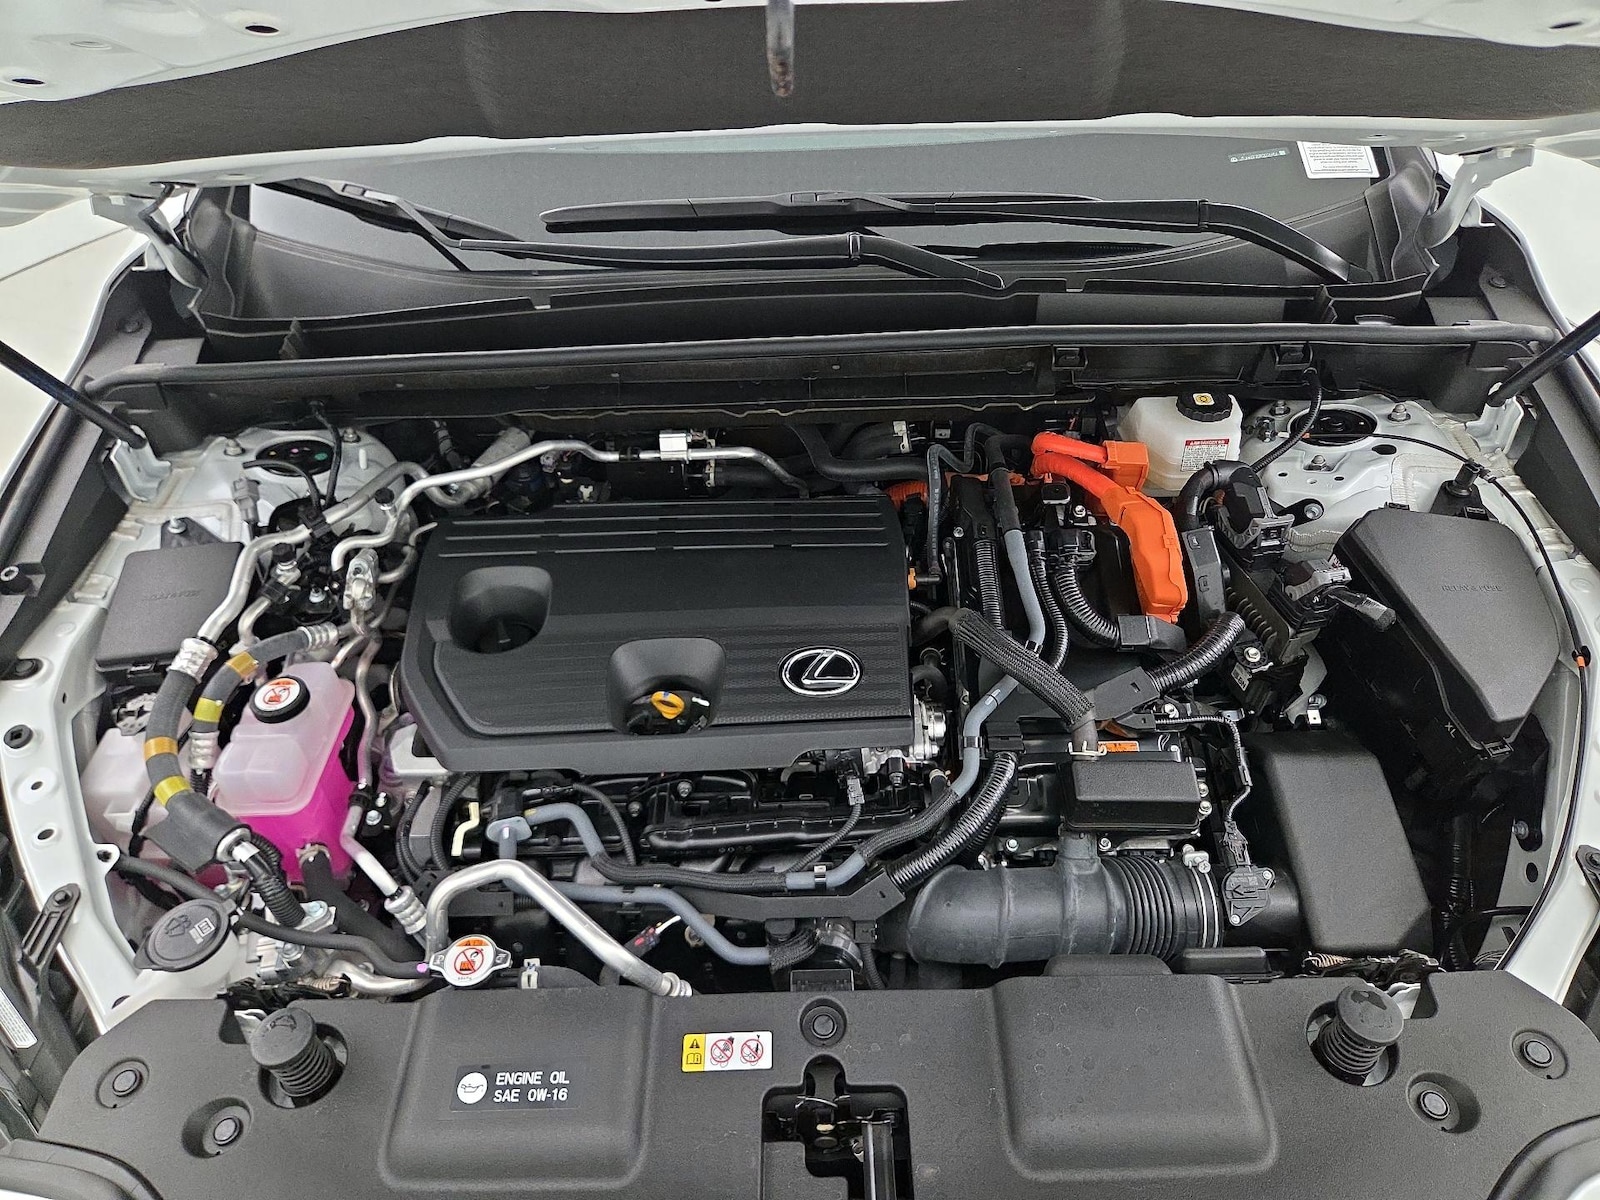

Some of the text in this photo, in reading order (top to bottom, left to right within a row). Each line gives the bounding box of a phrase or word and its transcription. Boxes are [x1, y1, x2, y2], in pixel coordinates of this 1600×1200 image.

[495, 1071, 570, 1086] ENGINE OIL
[493, 1088, 569, 1103] SAE 0W-16
